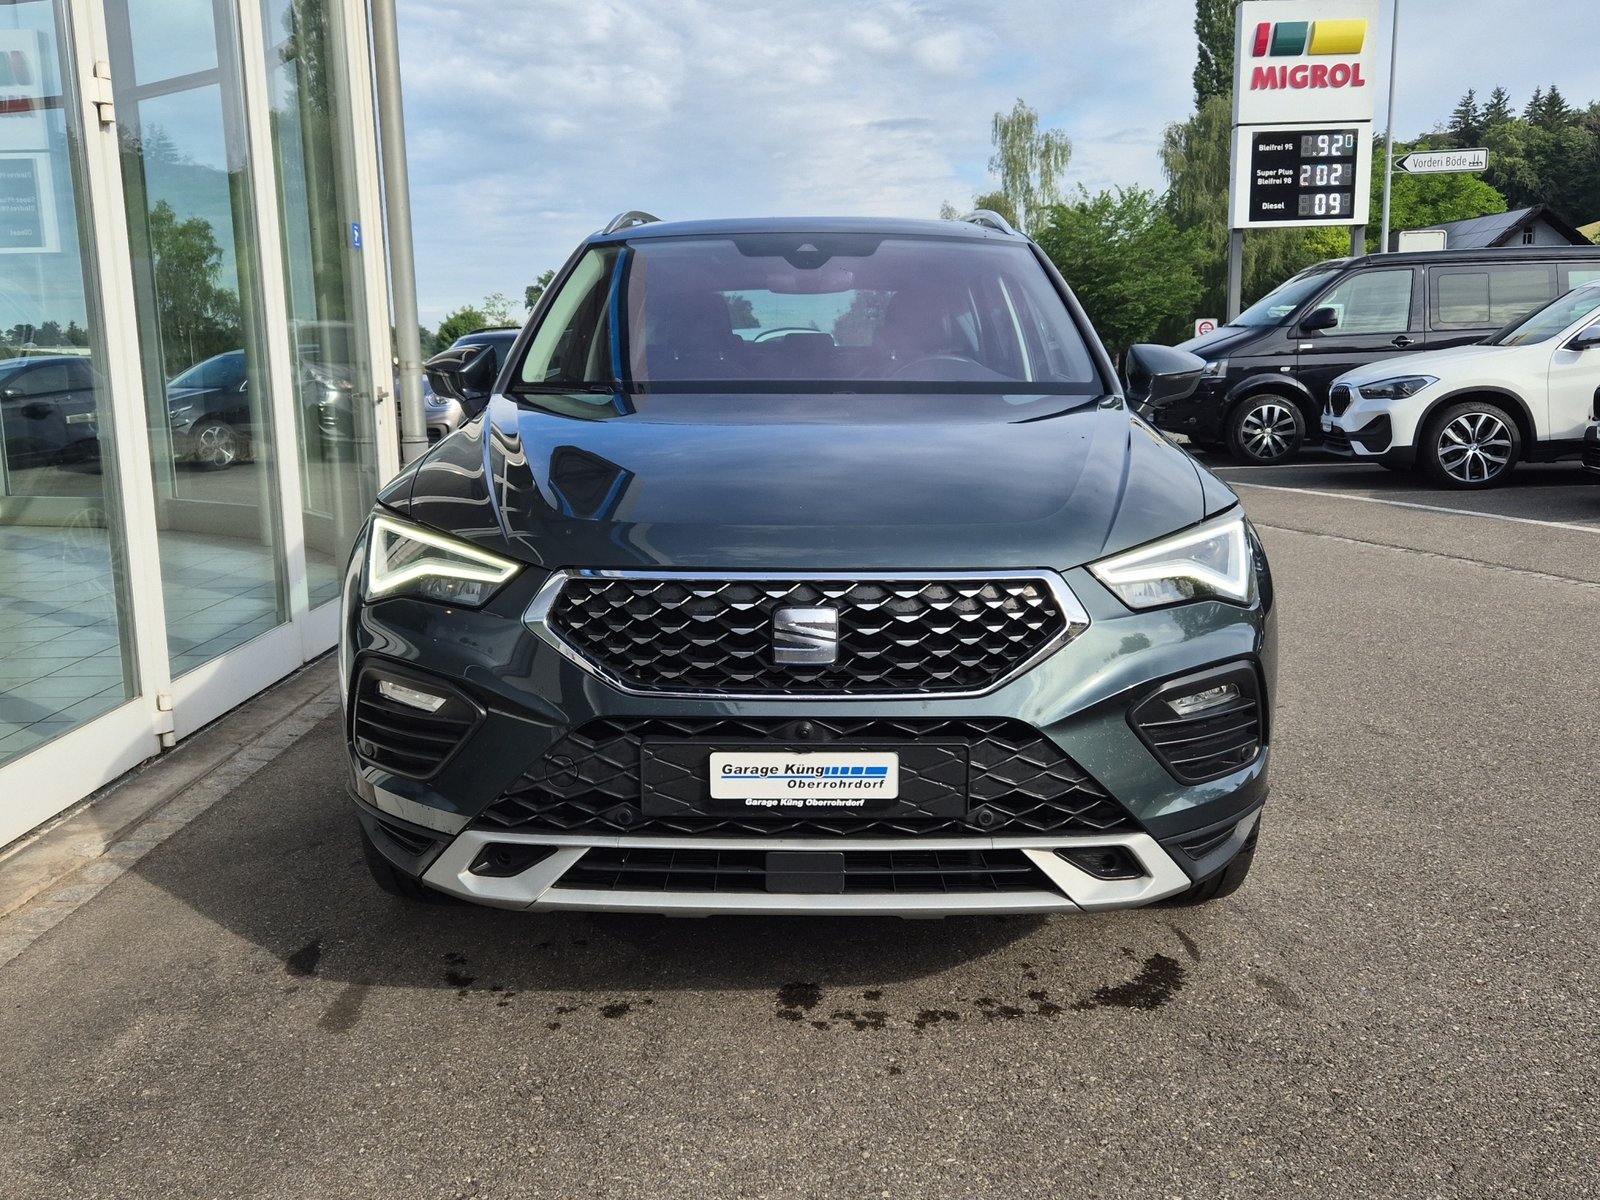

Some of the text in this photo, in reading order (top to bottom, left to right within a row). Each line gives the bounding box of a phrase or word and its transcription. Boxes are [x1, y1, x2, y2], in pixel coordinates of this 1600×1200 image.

[1251, 62, 1366, 91] MIGROL
[1413, 156, 1443, 168] Vorderi
[1256, 168, 1293, 177] Super Plus
[1257, 177, 1282, 185] Bleifrei
[1261, 202, 1285, 210] Diesel
[721, 763, 825, 778] Garage Küng
[787, 780, 885, 789] Oberrohrdorf
[745, 798, 865, 808] Garage Küng Oberrohrdorf
